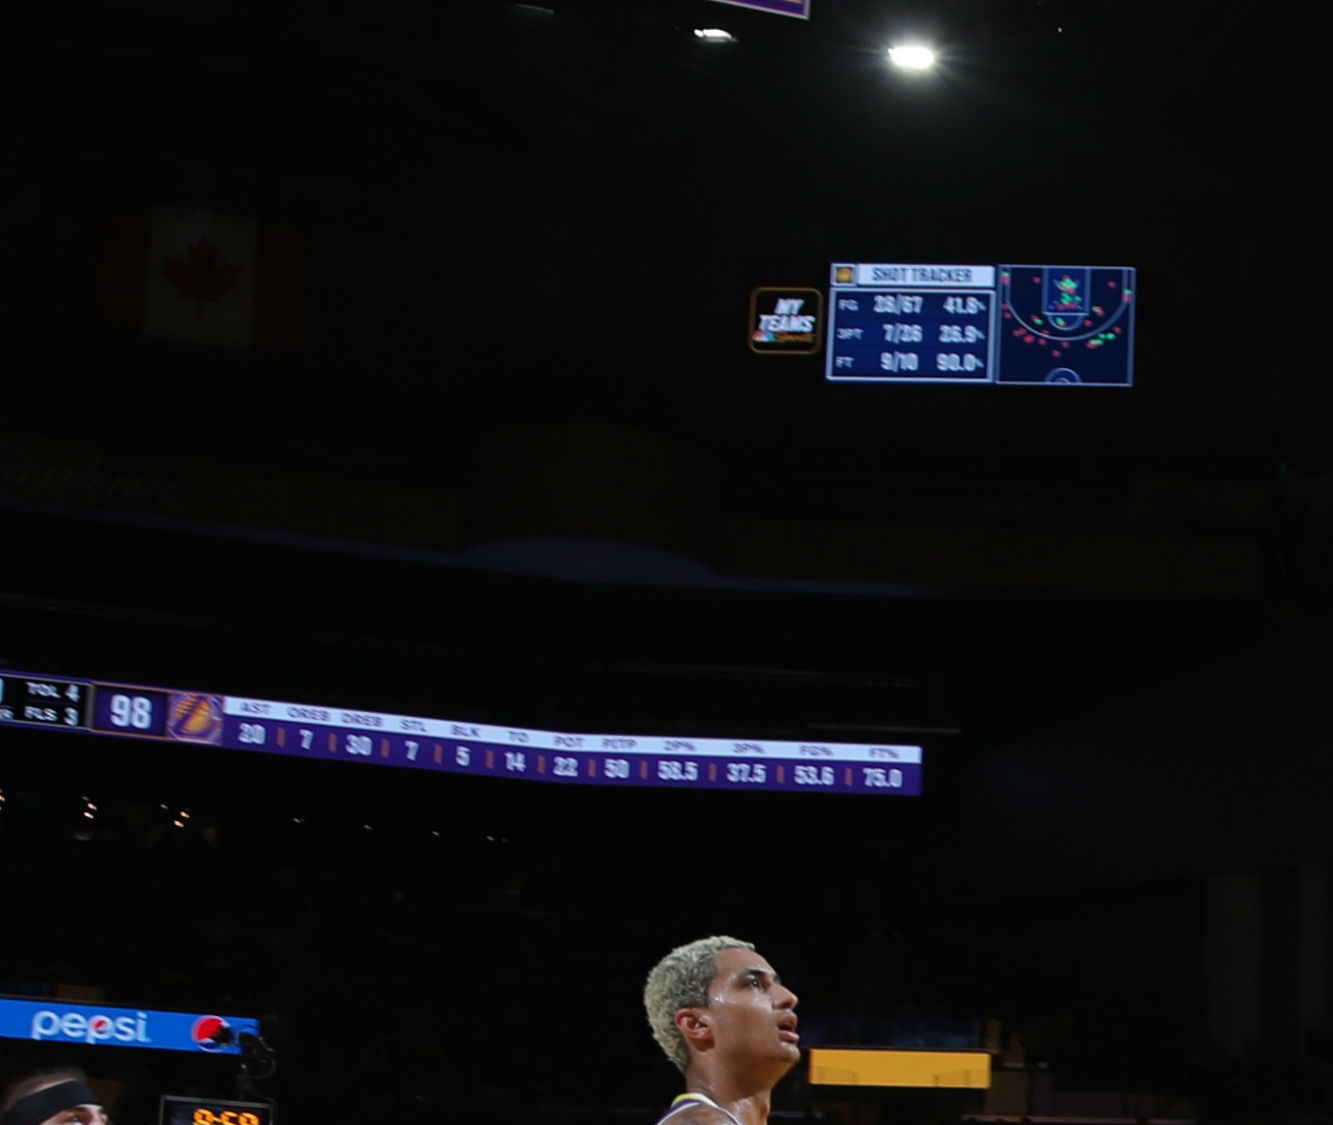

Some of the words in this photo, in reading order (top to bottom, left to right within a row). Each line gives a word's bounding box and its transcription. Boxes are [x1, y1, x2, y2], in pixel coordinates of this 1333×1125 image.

[870, 268, 907, 283] SHOT
[911, 268, 973, 284] TRACKER
[837, 328, 864, 340] 3PT
[835, 356, 854, 368] FT
[65, 683, 79, 702] 4
[64, 707, 78, 726] 3
[110, 694, 152, 729] 98
[240, 702, 272, 715] AST
[400, 719, 428, 732] STL
[451, 724, 480, 738] BLK
[508, 730, 529, 744] TO
[299, 729, 314, 750] 7
[345, 734, 373, 756] 30
[404, 740, 419, 761] 7
[455, 746, 470, 767] 5
[504, 751, 527, 772] 14
[553, 756, 579, 777] 22
[604, 758, 630, 779] 50
[862, 767, 902, 788] 75.0
[31, 1009, 152, 1045] pepsi
